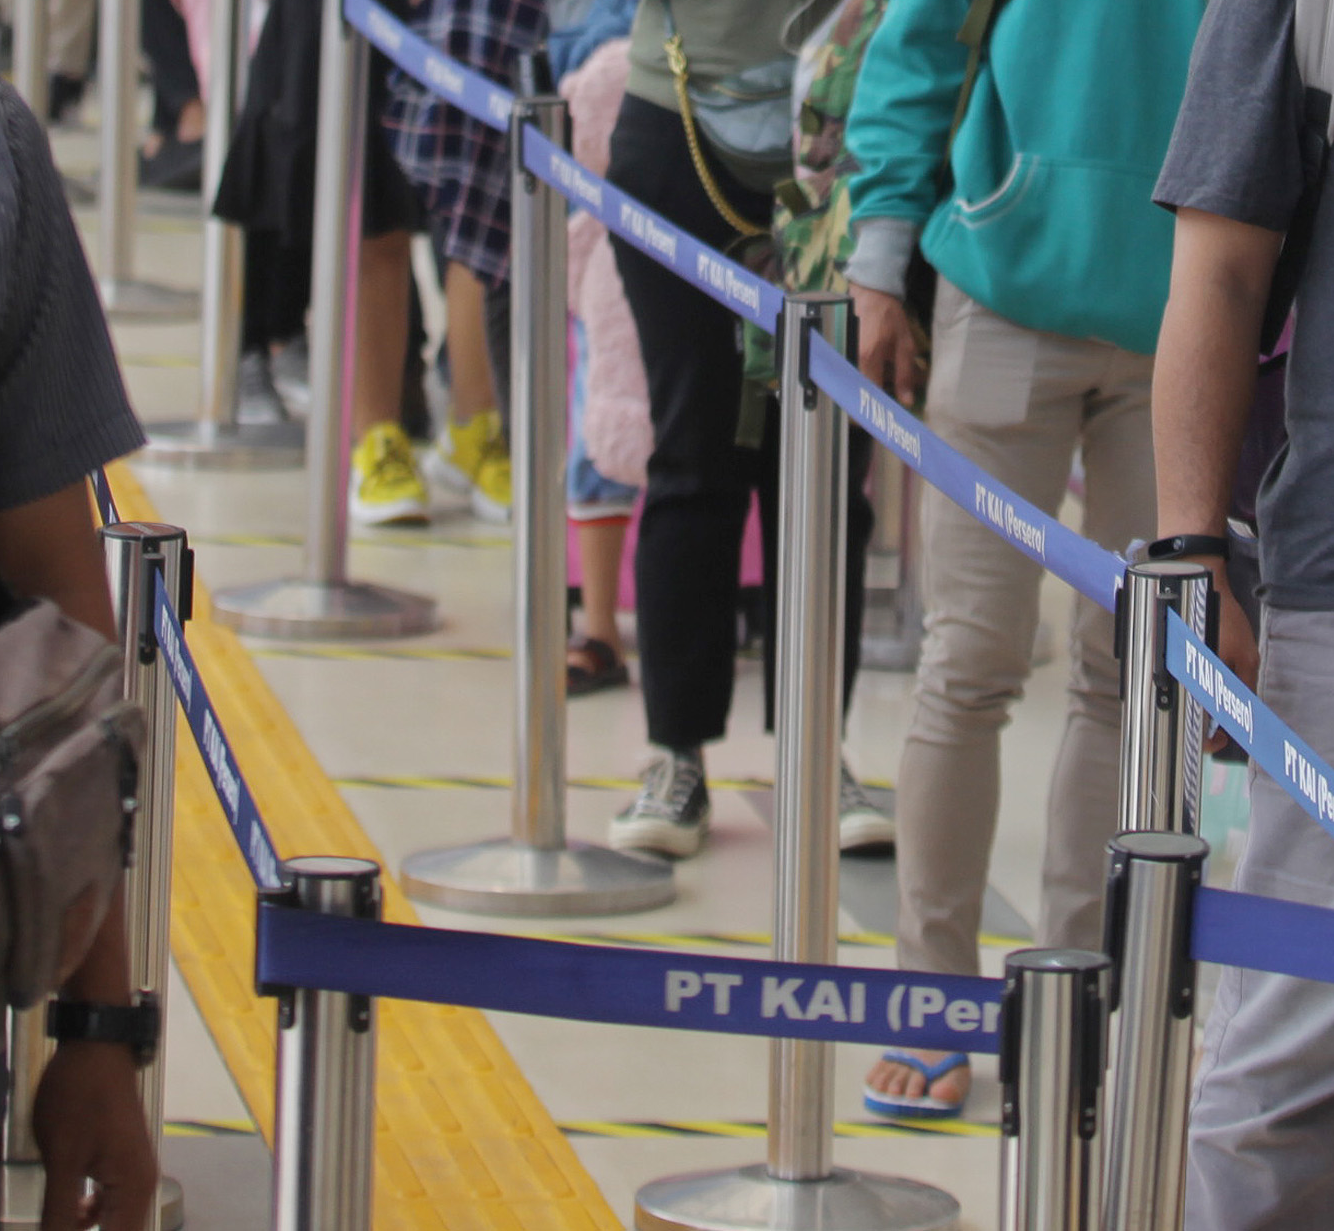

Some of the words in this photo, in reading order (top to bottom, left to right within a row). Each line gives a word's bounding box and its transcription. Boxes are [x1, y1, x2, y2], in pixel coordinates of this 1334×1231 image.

[975, 480, 987, 517] PT
[987, 490, 1005, 529] KAI
[1185, 639, 1198, 681] PT
[1198, 651, 1215, 697] KAI
[1215, 668, 1254, 745] (Persero)
[1283, 738, 1298, 784] PT
[1298, 752, 1316, 805] KAI
[665, 970, 743, 1015] PT
[760, 975, 867, 1023] KAI
